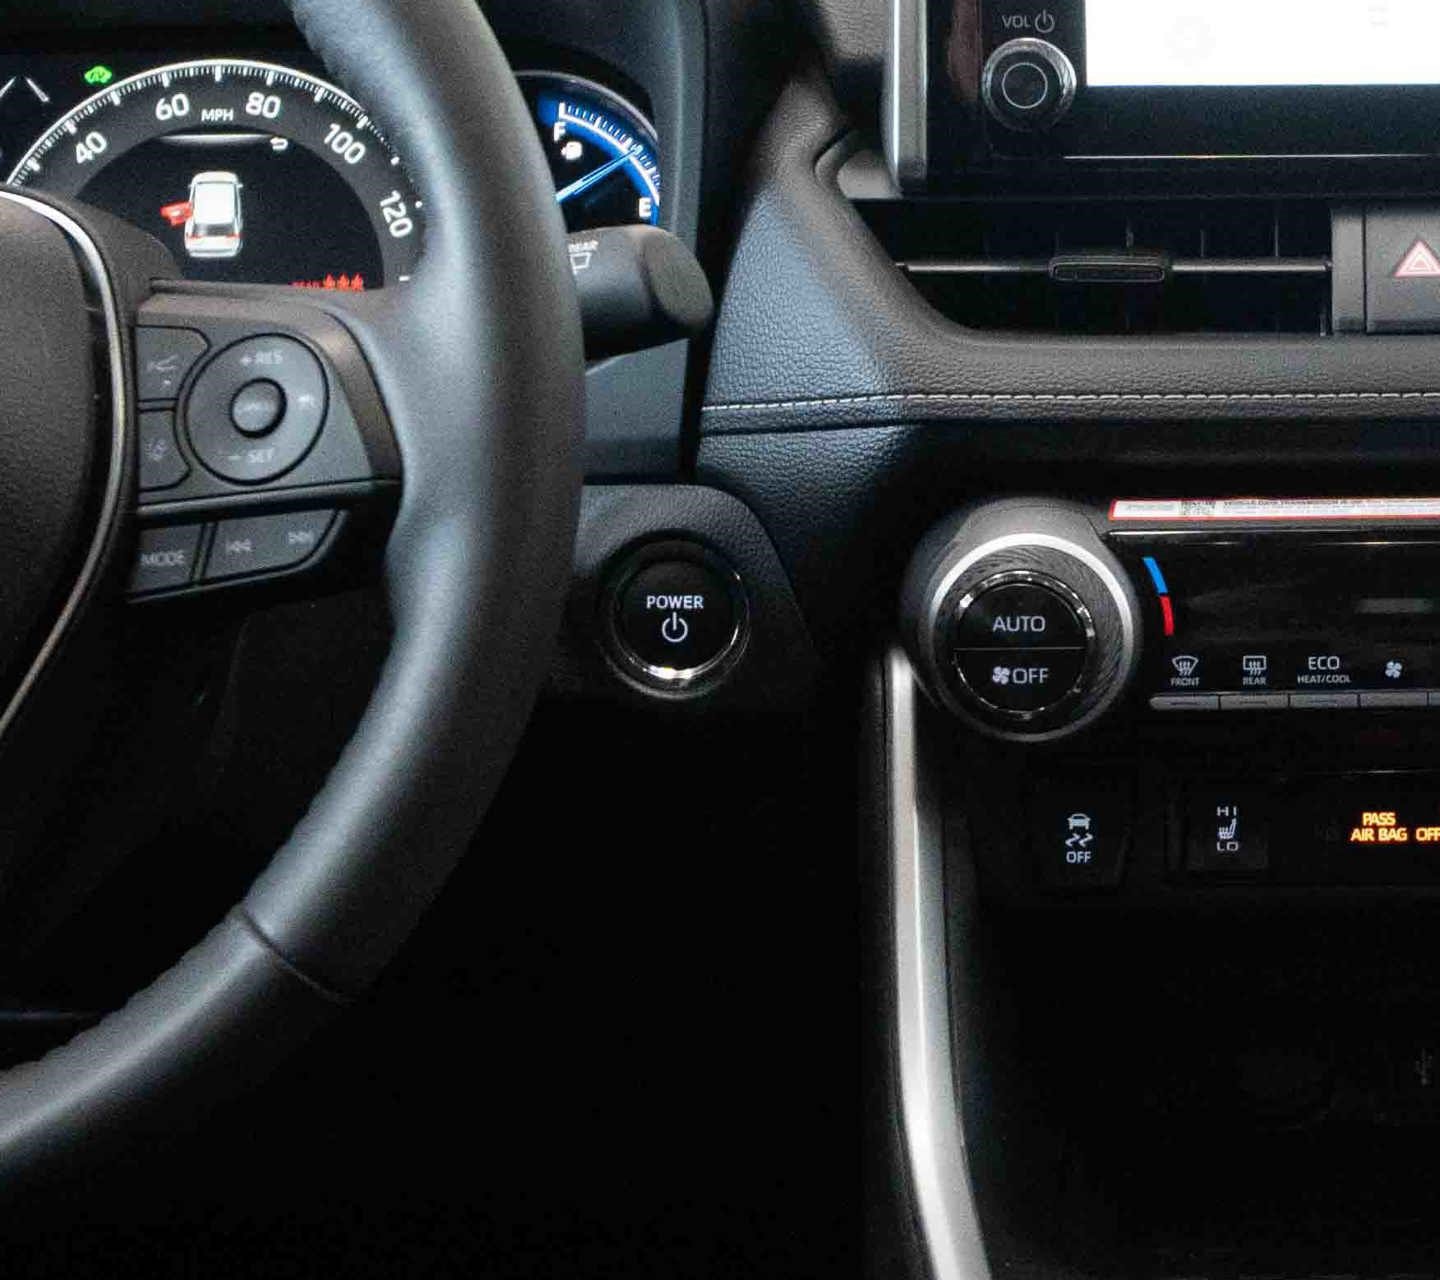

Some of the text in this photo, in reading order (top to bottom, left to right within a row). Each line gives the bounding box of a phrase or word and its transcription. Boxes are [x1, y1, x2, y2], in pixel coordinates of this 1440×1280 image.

[1001, 15, 1031, 29] VOL
[155, 93, 190, 121] 60
[245, 91, 281, 119] 80
[201, 108, 234, 121] MPH
[553, 121, 566, 142] F
[74, 130, 107, 164] 40
[322, 122, 366, 164] 100
[379, 189, 413, 238] 120
[638, 197, 651, 217] E
[141, 550, 185, 565] MODE
[647, 595, 704, 609] POWER
[992, 615, 1046, 632] AUTO
[1308, 655, 1340, 670] ECO
[1012, 667, 1049, 684] OFF
[1170, 676, 1200, 687] FRONT
[1242, 676, 1267, 686] REAR
[1297, 674, 1351, 684] HEAT/COOL
[1216, 806, 1237, 817] HI
[1363, 812, 1396, 825] PASS
[1350, 828, 1375, 841] AIR
[1378, 827, 1407, 841] BAG
[1216, 841, 1239, 852] LO
[1066, 850, 1091, 863] OFF
